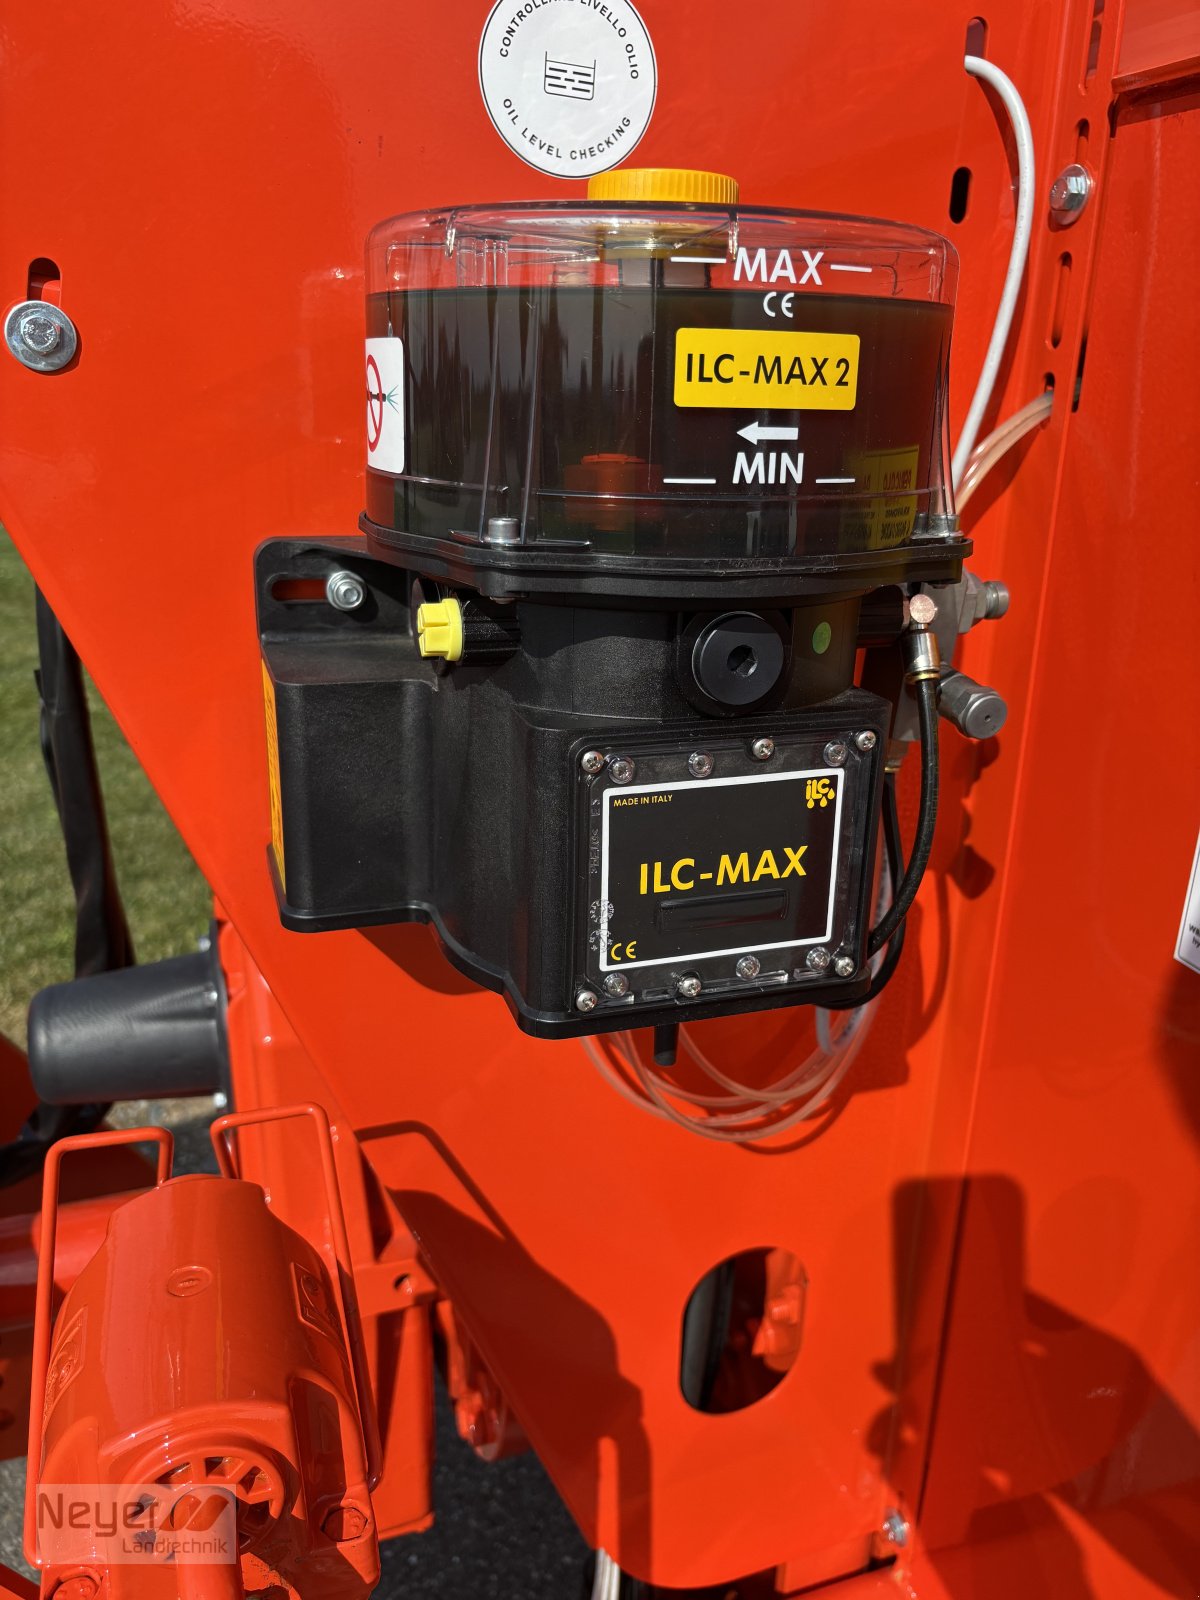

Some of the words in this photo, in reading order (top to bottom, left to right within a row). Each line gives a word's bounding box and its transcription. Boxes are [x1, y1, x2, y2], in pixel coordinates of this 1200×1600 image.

[499, 0, 574, 57] CONTROLL
[625, 43, 639, 79] OLIO
[503, 98, 521, 125] OIL
[521, 127, 562, 158] LEVEL
[569, 117, 631, 160] CHECKING
[733, 247, 824, 285] MAX
[732, 452, 804, 484] MIN
[613, 797, 639, 807] MADE
[640, 796, 650, 805] IN
[652, 794, 673, 804] ITALY
[639, 845, 808, 895] ILC-MAX
